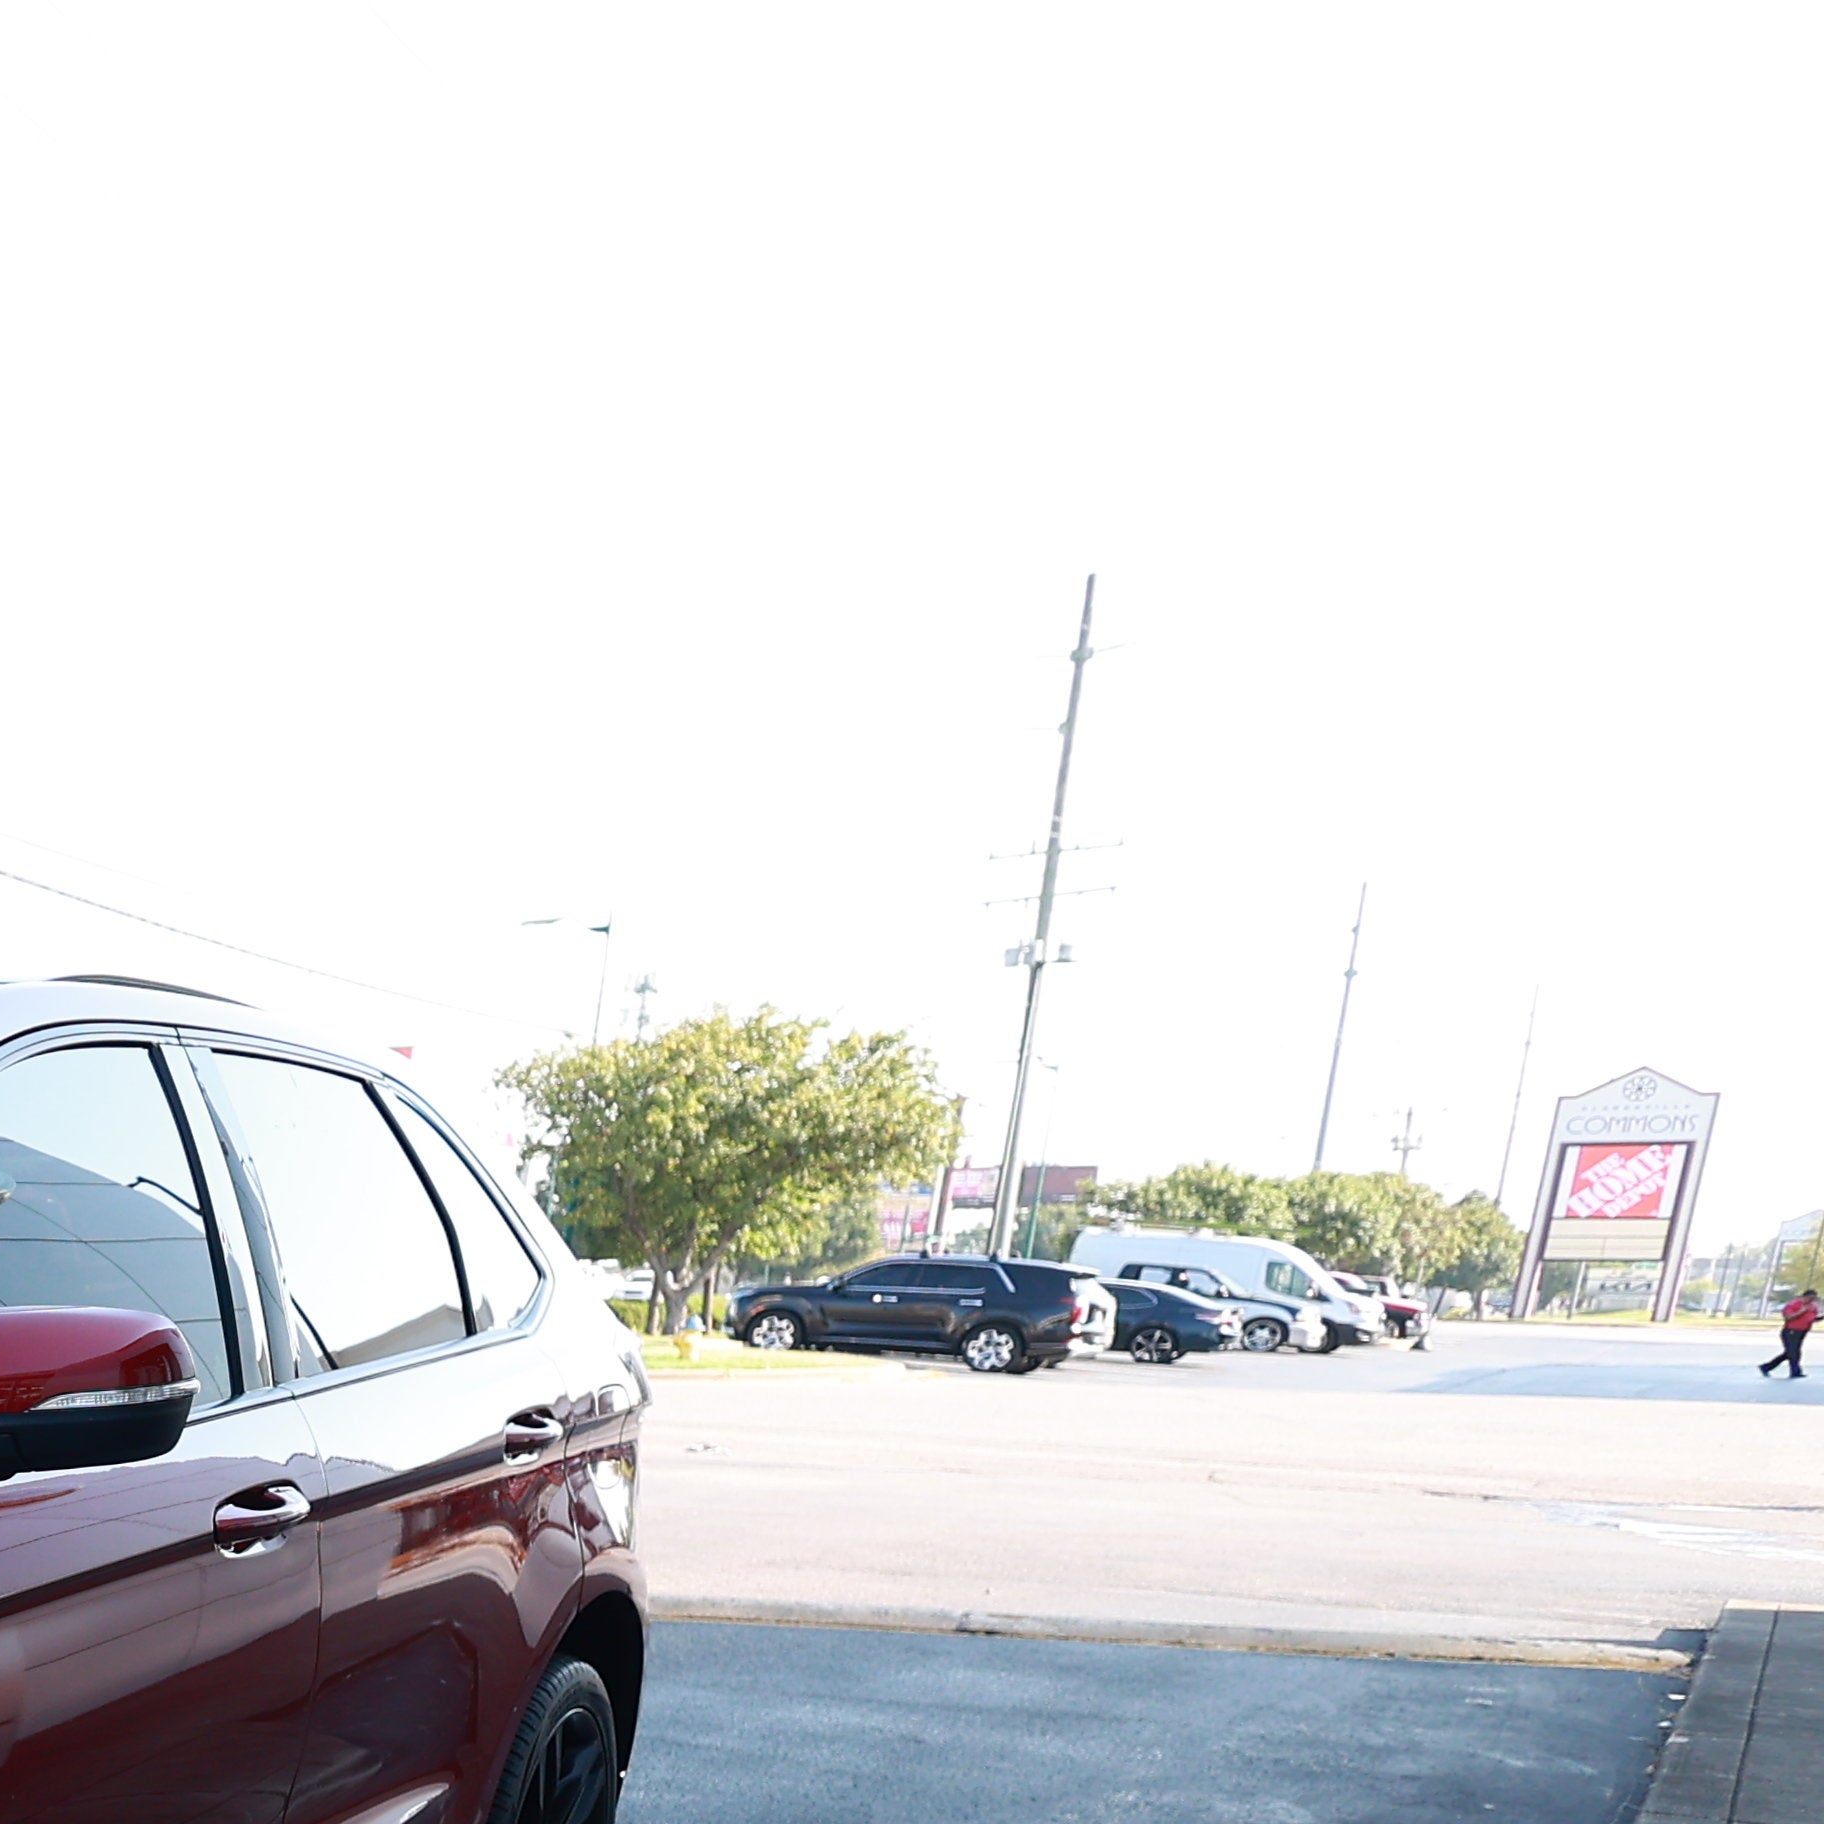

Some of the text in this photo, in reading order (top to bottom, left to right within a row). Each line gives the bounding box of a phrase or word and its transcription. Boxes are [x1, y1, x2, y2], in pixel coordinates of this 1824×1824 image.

[1565, 1113, 1698, 1136] COMMONS
[1568, 1144, 1670, 1218] HOME
[1580, 1152, 1626, 1182] THE
[1601, 1172, 1666, 1218] DEPOT
